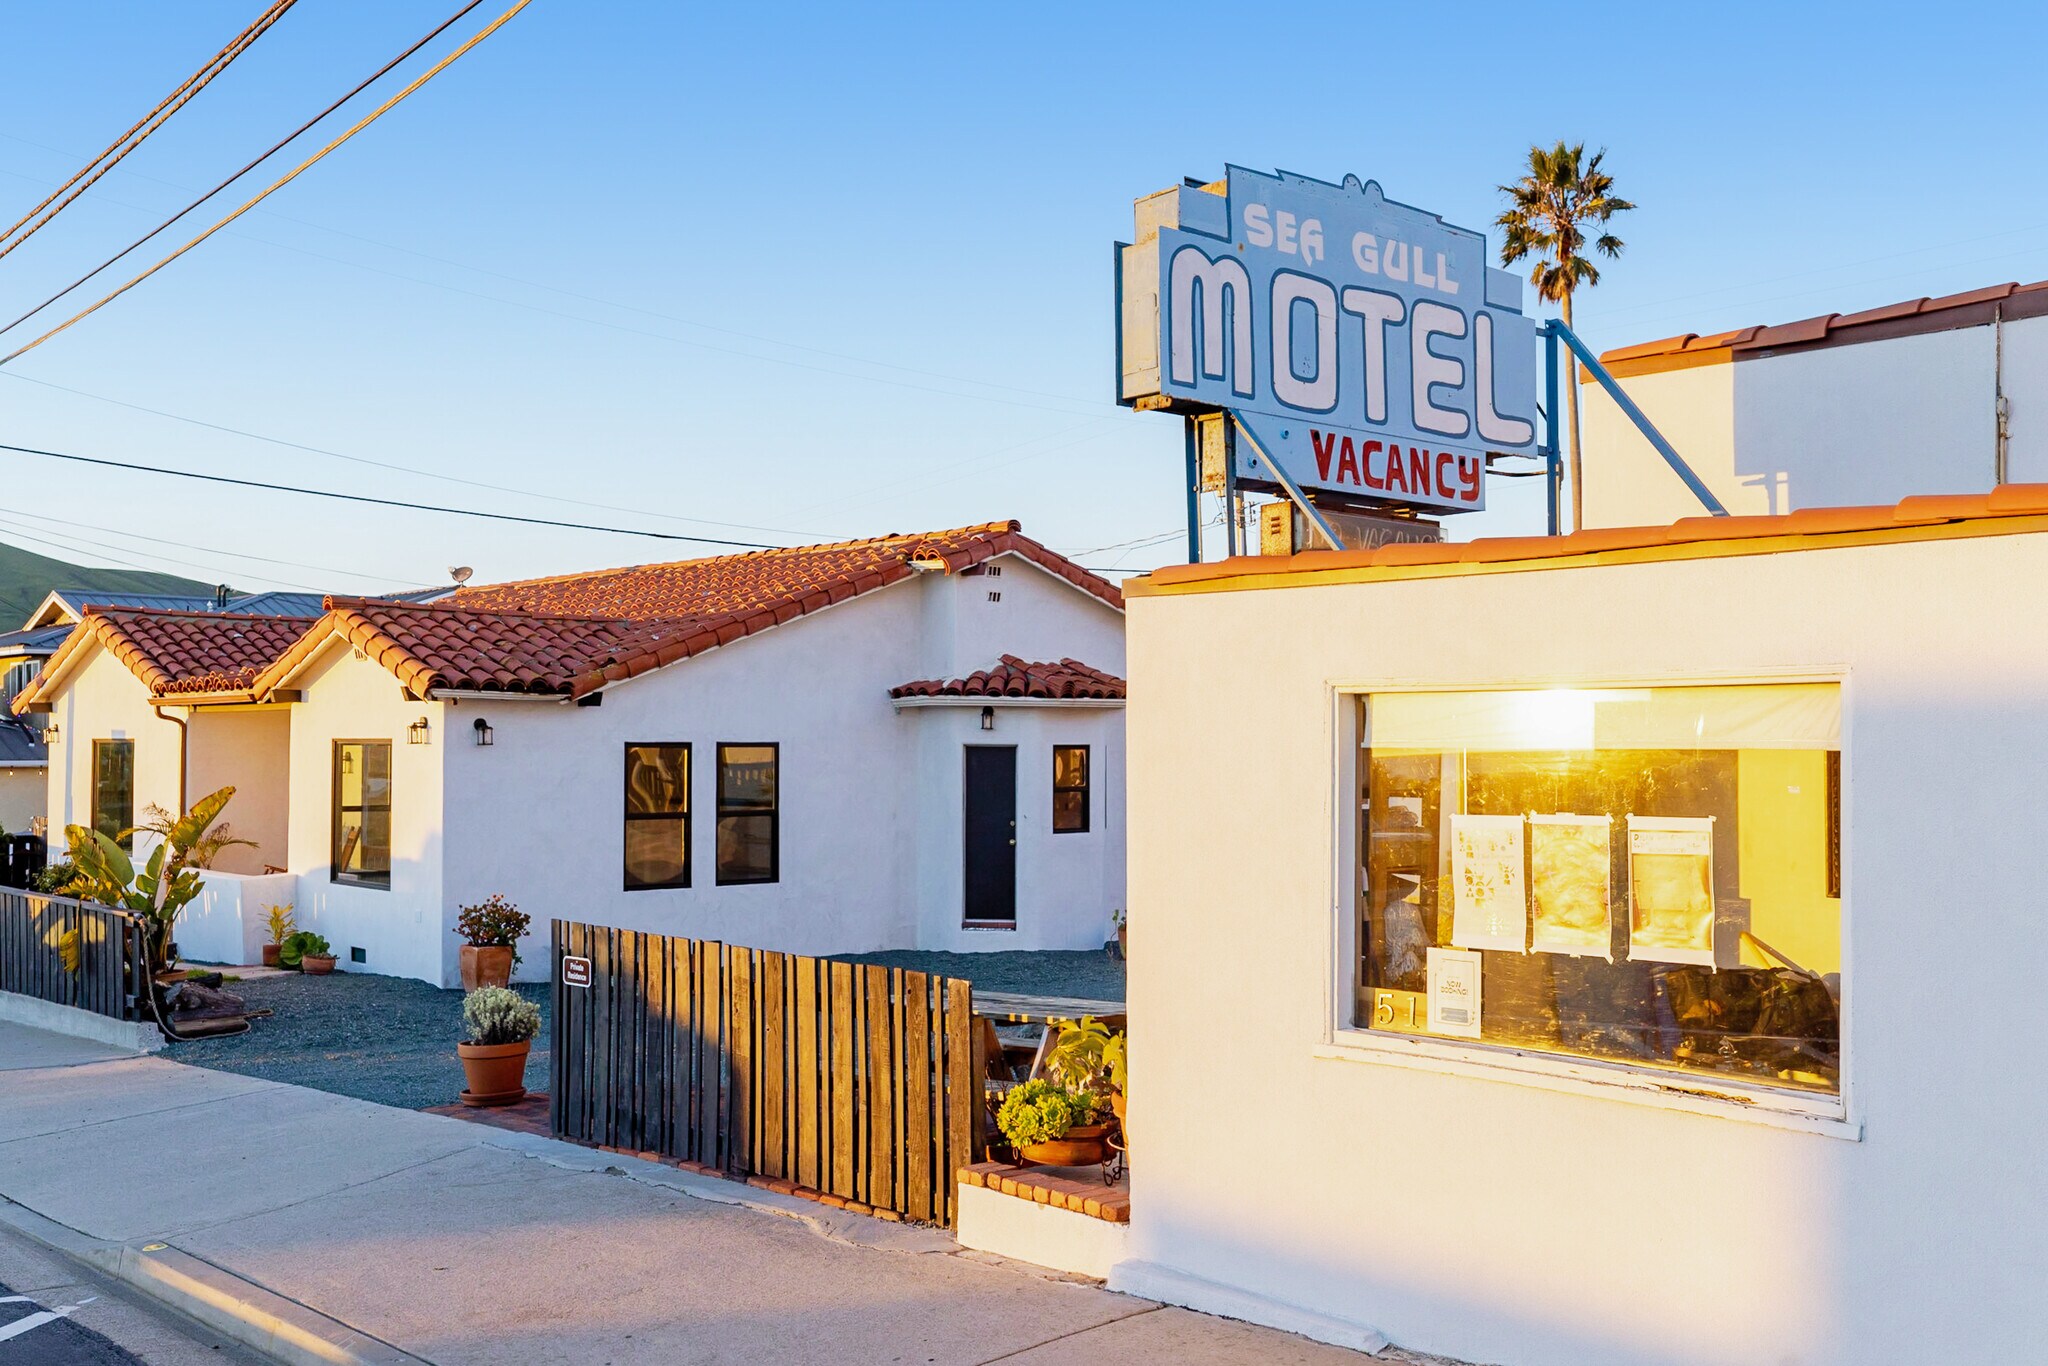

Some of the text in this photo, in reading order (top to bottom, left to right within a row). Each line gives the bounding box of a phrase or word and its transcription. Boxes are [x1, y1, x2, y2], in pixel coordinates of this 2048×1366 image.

[1243, 203, 1460, 295] SEA GULL
[1169, 243, 1535, 446] MOTEL
[1310, 428, 1480, 502] VACANCY
[567, 971, 586, 981] Residence
[570, 960, 584, 972] Private
